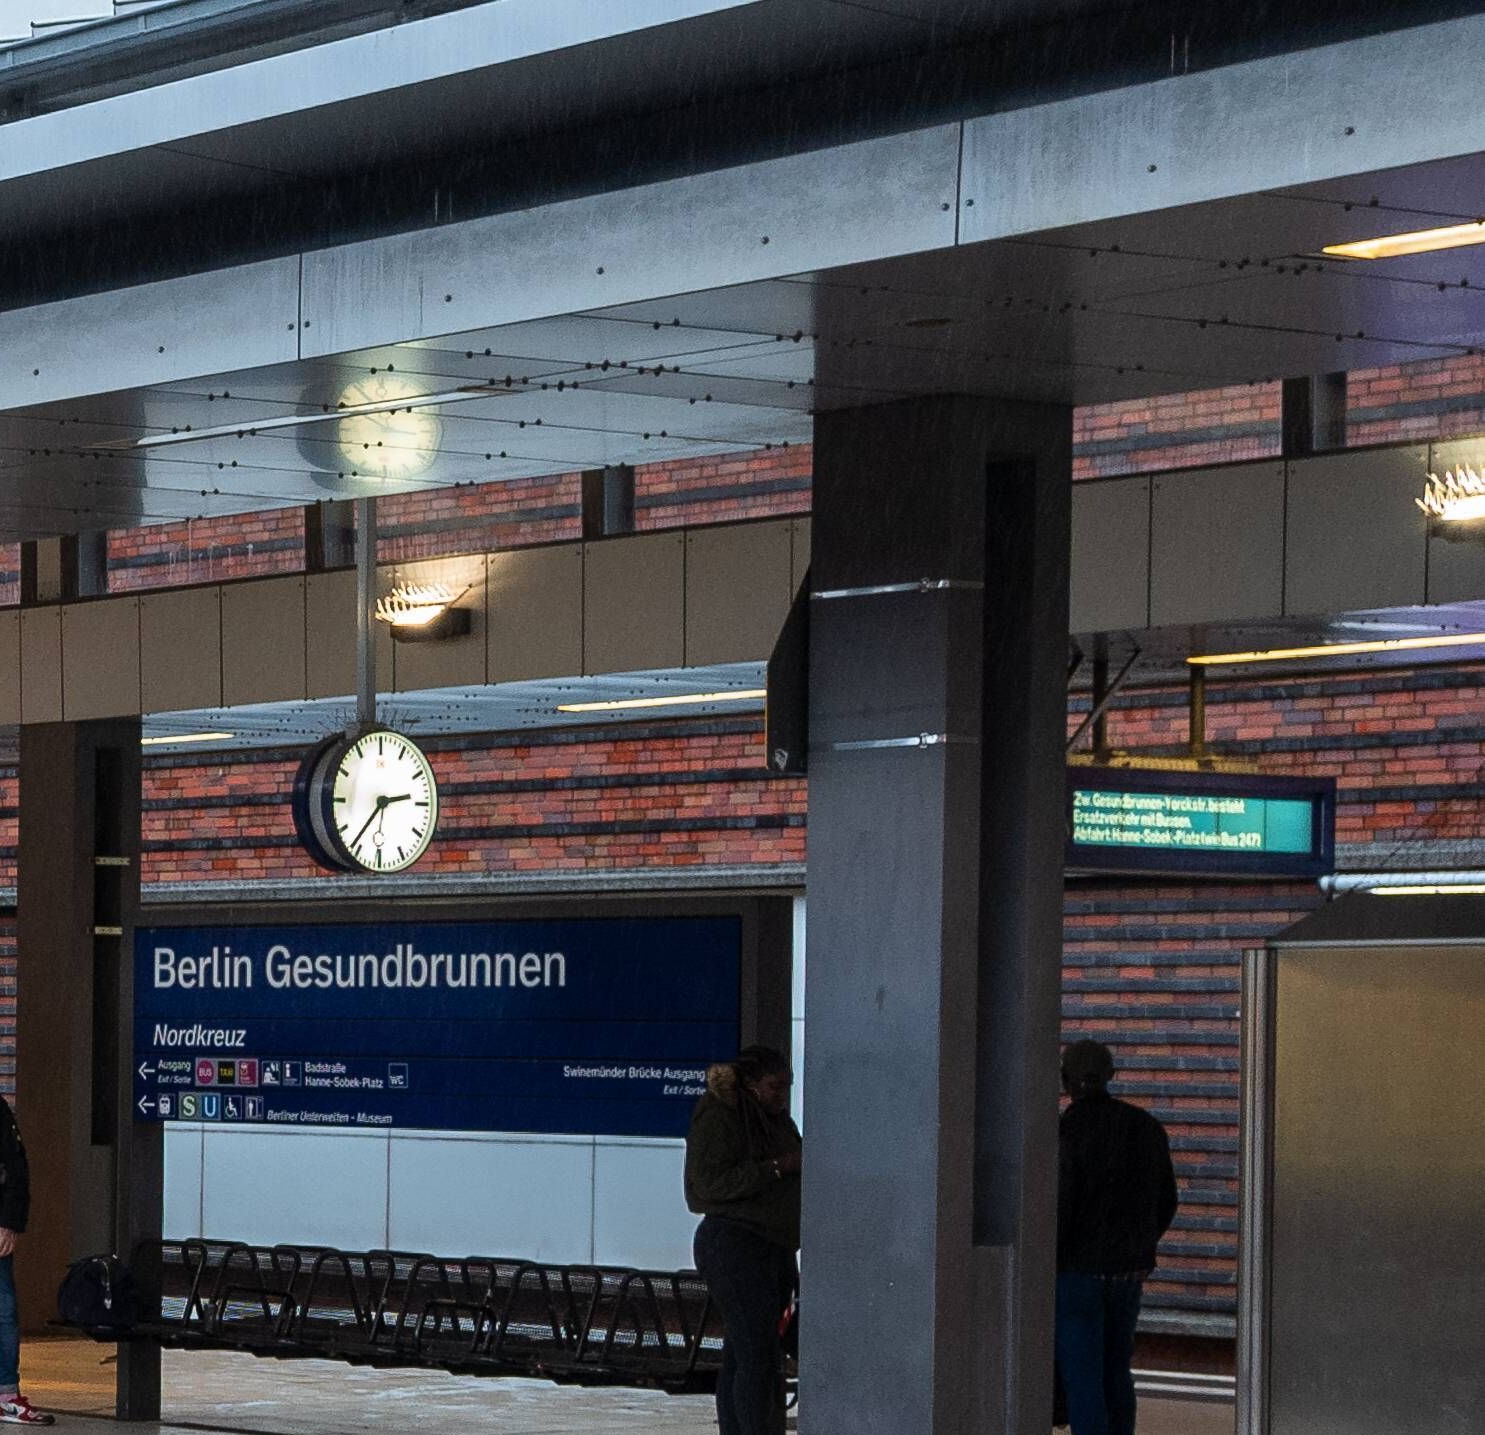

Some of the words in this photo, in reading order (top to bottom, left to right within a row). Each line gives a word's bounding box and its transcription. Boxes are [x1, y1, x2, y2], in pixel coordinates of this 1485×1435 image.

[153, 946, 252, 988] Berlin
[265, 944, 566, 988] Gesundbrunnen
[153, 1022, 247, 1047] Nordkreuz
[158, 1060, 191, 1072] Ausgang
[198, 1068, 212, 1077] BUS
[305, 1061, 346, 1073] Badstraße
[563, 1065, 626, 1079] Swinemünder
[629, 1066, 662, 1079] Brücke
[663, 1067, 706, 1082] Ausgang
[305, 1076, 384, 1088] Hanne-Sobek-Platz
[183, 1095, 195, 1117] S
[204, 1096, 216, 1117] U
[266, 1109, 297, 1122] Berliner
[357, 1112, 393, 1124] Museum
